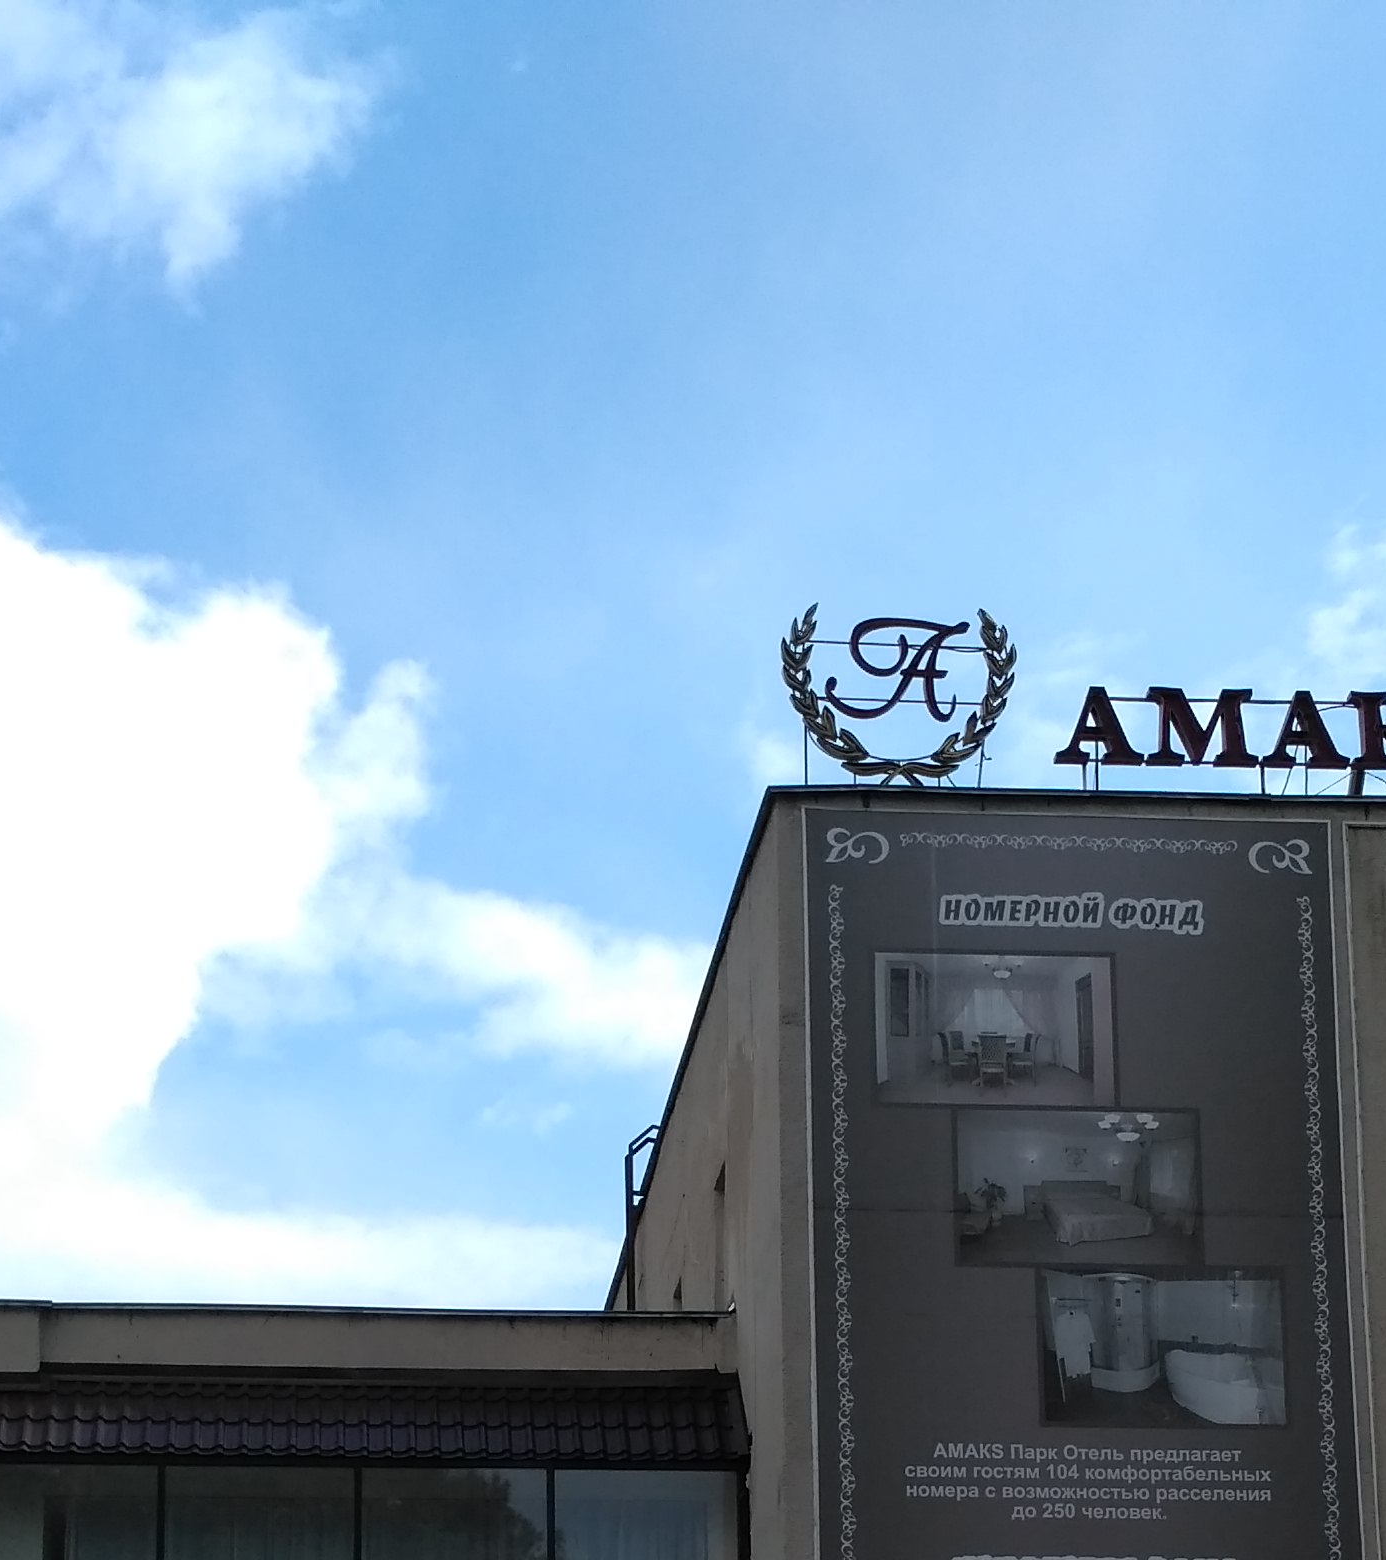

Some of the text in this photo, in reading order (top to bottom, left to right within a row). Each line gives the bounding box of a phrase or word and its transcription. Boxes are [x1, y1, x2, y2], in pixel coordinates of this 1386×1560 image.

[941, 894, 1203, 933] НОМЕРНОЙ ФОНД
[933, 1442, 1242, 1464] AMAKS Парк Отель предлагает
[904, 1464, 1272, 1484] своим гостям 104 комфортабельных
[906, 1483, 1272, 1503] номера с возможностью расселения
[1011, 1503, 1168, 1521] до 250 человек.
